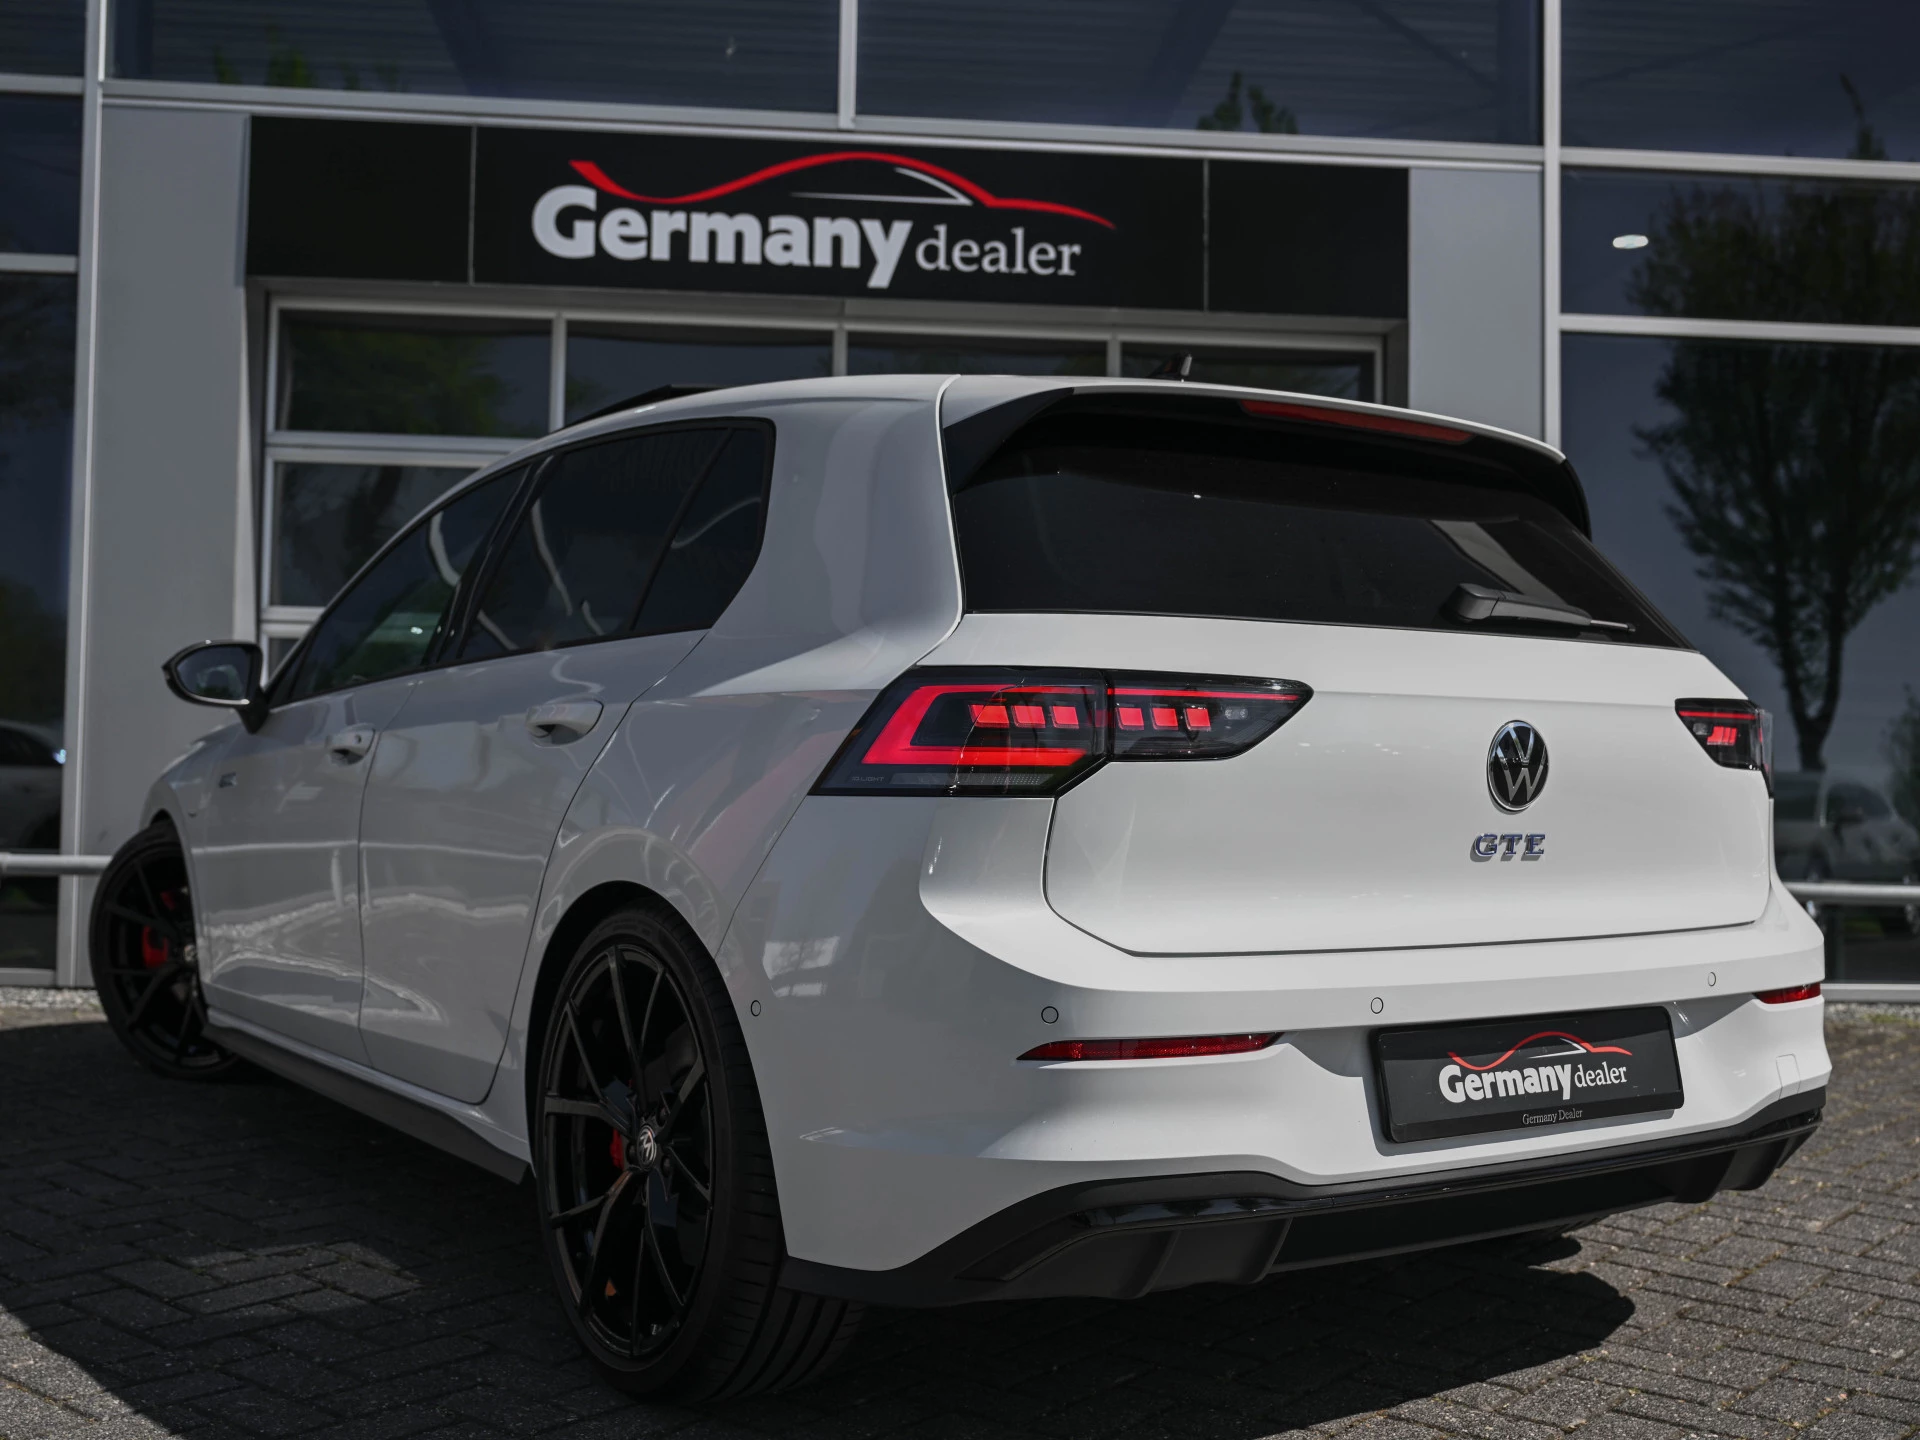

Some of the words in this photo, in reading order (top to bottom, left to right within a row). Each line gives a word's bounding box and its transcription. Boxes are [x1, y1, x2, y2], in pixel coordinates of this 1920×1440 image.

[532, 185, 912, 288] Germany
[915, 225, 1081, 275] dealer
[1490, 721, 1548, 805] VW
[1474, 833, 1546, 857] GTE
[1438, 1063, 1571, 1103] Germany
[1574, 1061, 1627, 1088] dealer
[1522, 1113, 1557, 1125] Germany
[1558, 1108, 1583, 1121] Dealer
